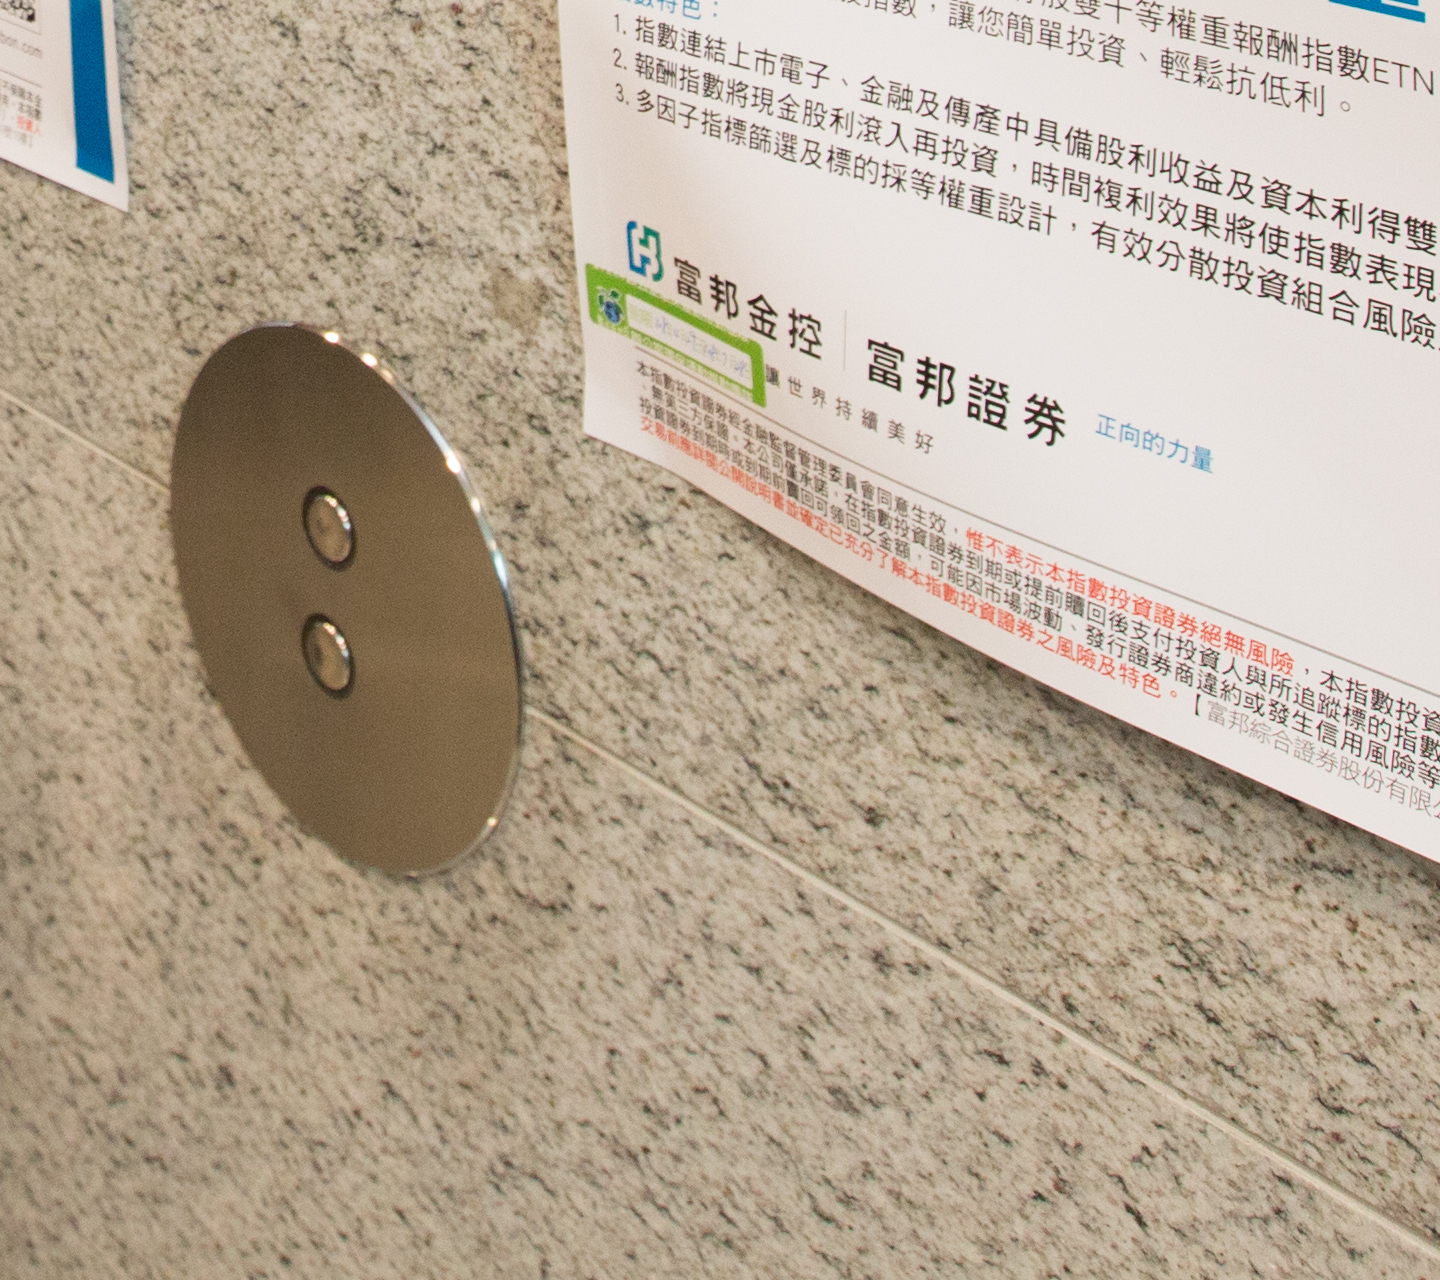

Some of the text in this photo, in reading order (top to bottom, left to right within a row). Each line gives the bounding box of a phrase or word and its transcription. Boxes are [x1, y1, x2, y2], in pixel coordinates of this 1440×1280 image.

[673, 257, 823, 360] 富邦金控
[867, 338, 1067, 448] 富邦證券
[1095, 413, 1215, 474] 正向的力量
